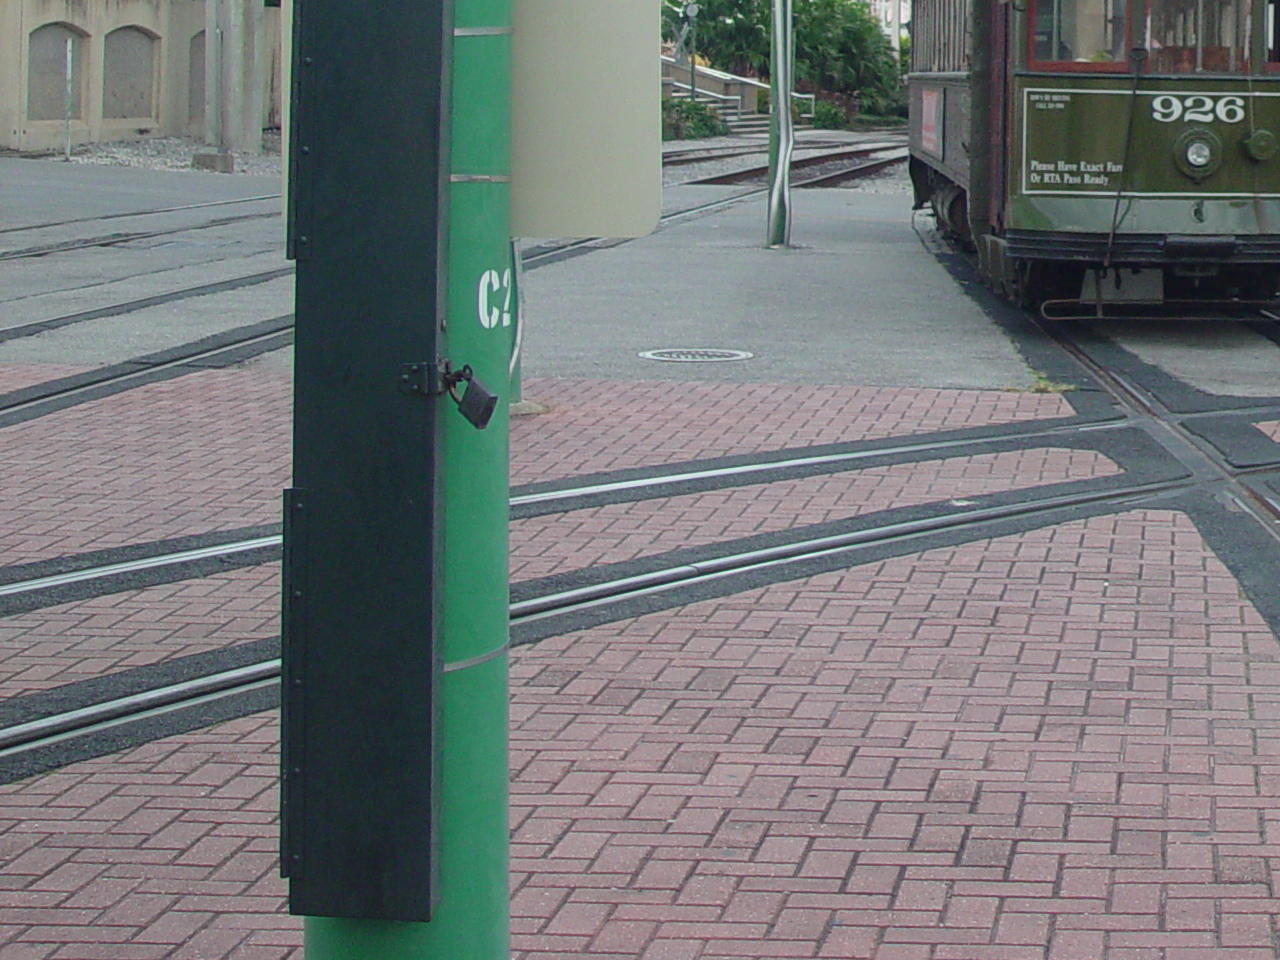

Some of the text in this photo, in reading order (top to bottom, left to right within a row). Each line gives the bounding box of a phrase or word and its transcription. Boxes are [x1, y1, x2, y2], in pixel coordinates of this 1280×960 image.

[1152, 95, 1245, 123] 926
[1030, 160, 1055, 171] Please
[1057, 161, 1078, 172] Have
[1080, 161, 1104, 172] Exact
[1030, 173, 1109, 186] Or RTA Pass Ready
